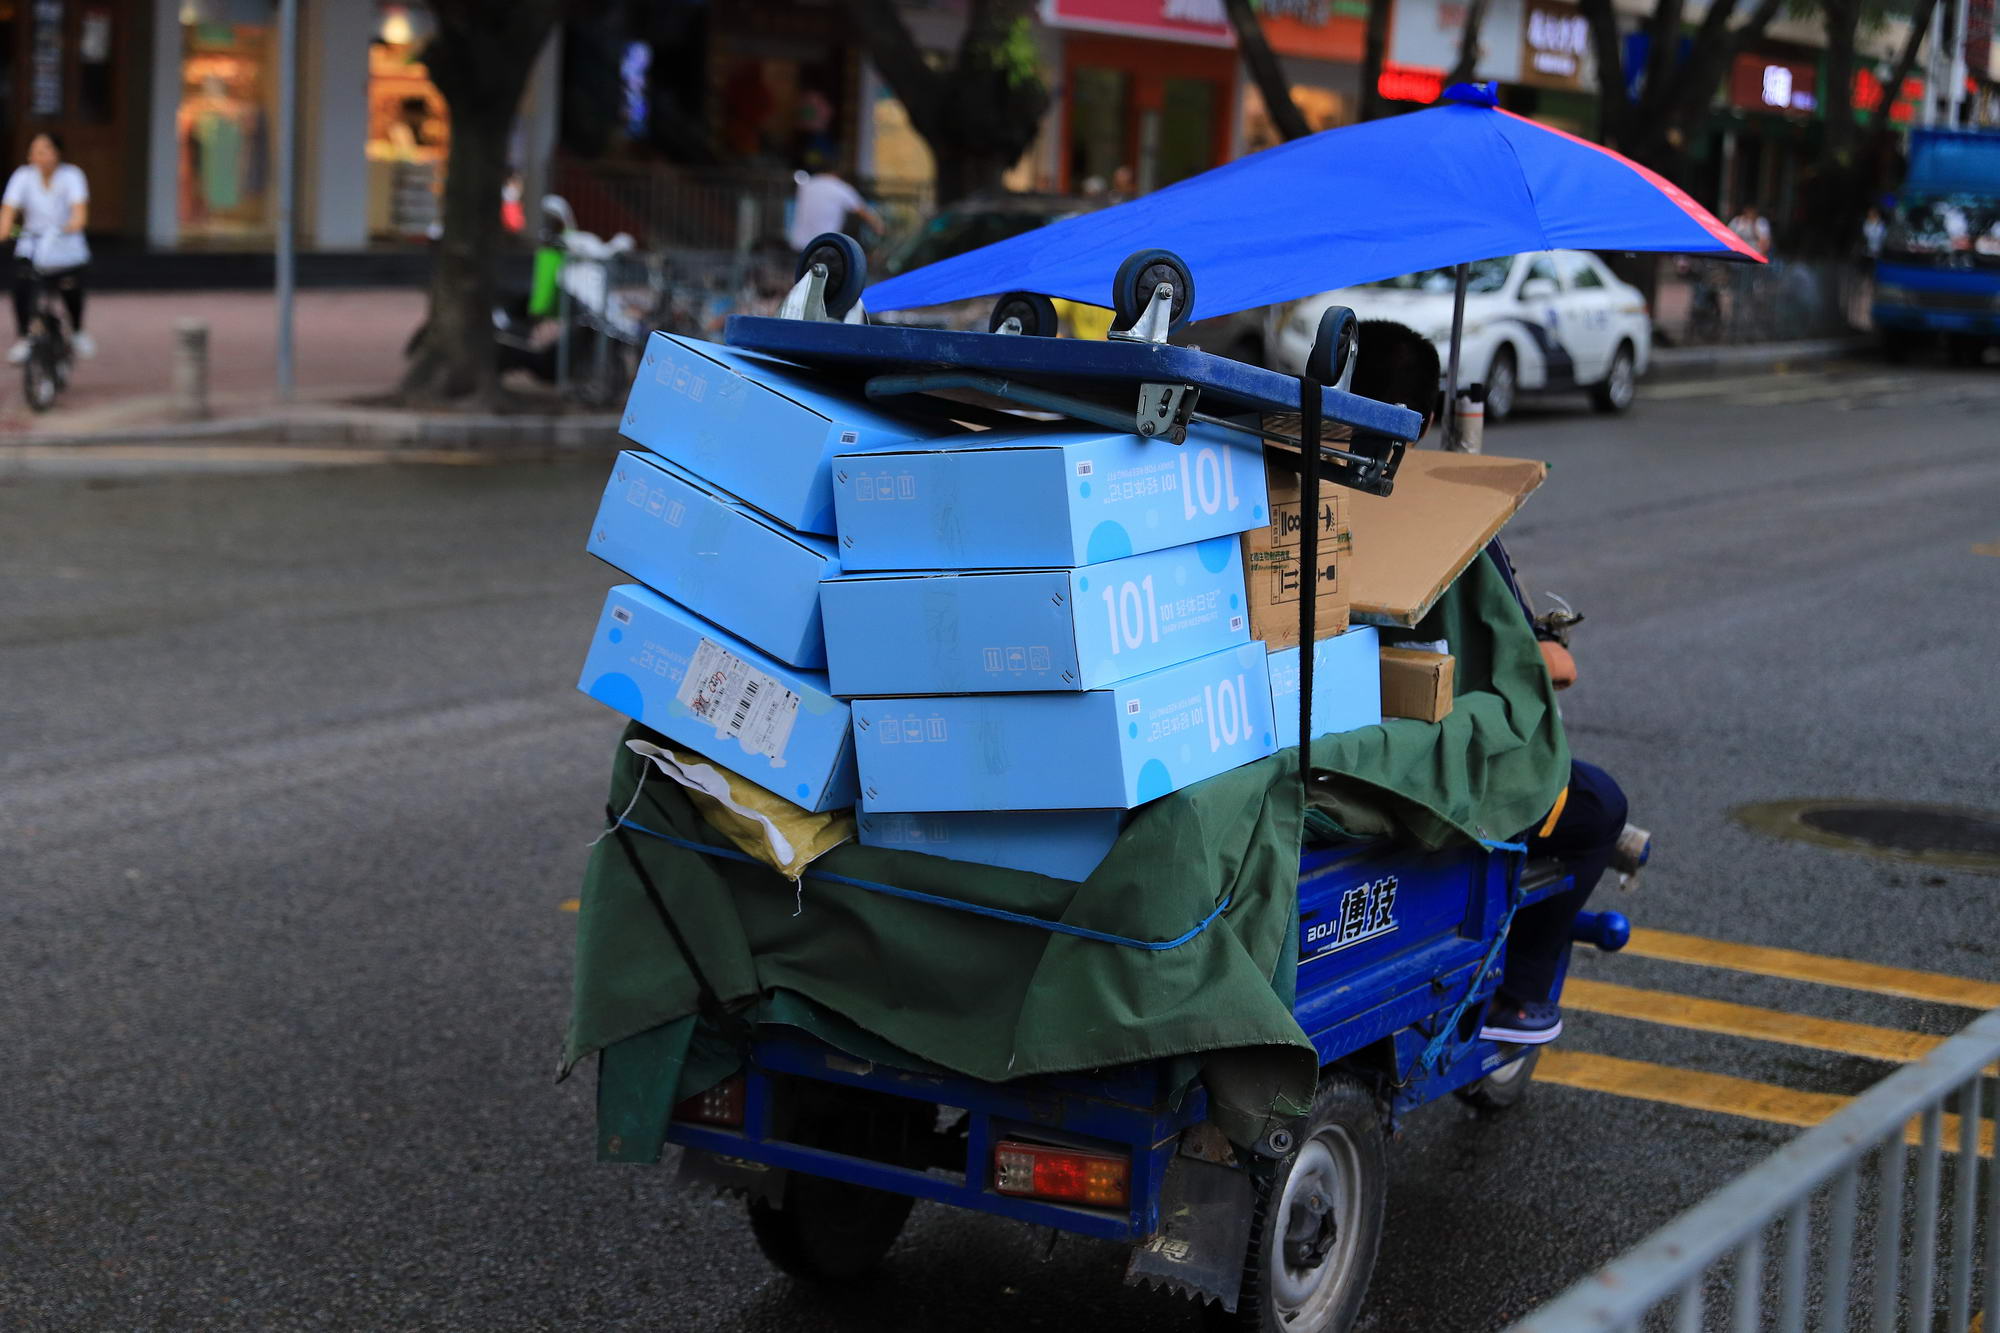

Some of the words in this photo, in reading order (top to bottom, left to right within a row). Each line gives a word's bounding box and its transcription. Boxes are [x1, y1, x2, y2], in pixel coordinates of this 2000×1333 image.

[1180, 444, 1239, 520] 101
[1102, 574, 1159, 655] 101
[1160, 602, 1174, 622] 101
[1204, 673, 1253, 753] 101
